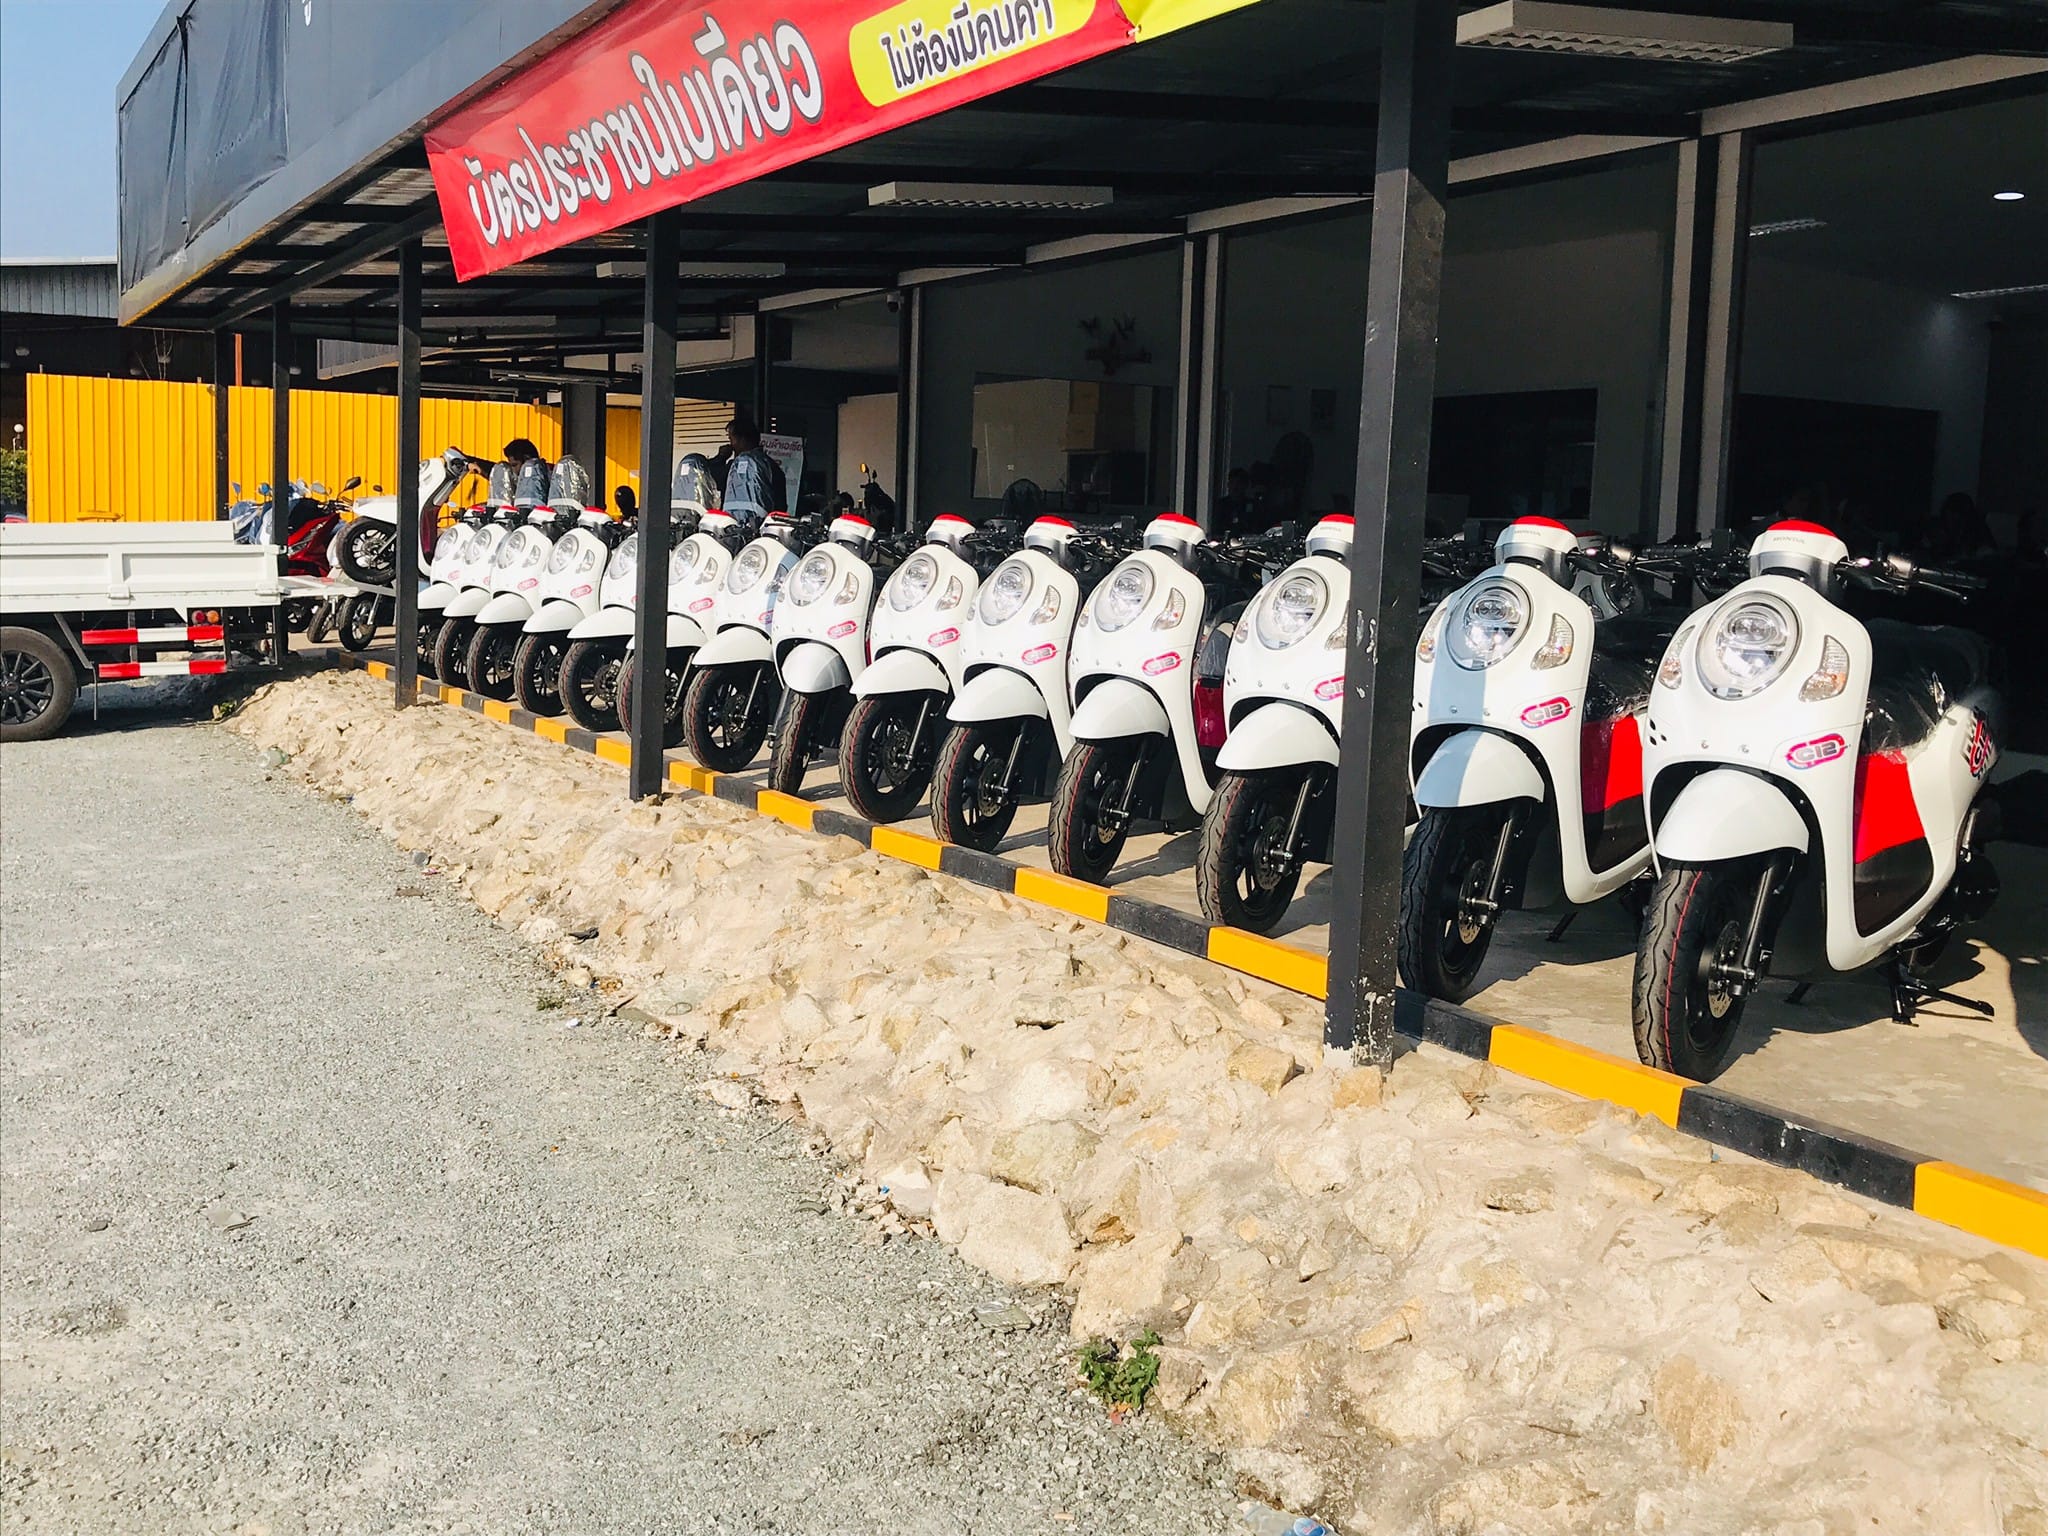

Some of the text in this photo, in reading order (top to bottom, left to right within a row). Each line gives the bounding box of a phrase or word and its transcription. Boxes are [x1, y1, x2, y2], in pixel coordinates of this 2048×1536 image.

[463, 11, 823, 247] บัตรประชาชนใบเดียว
